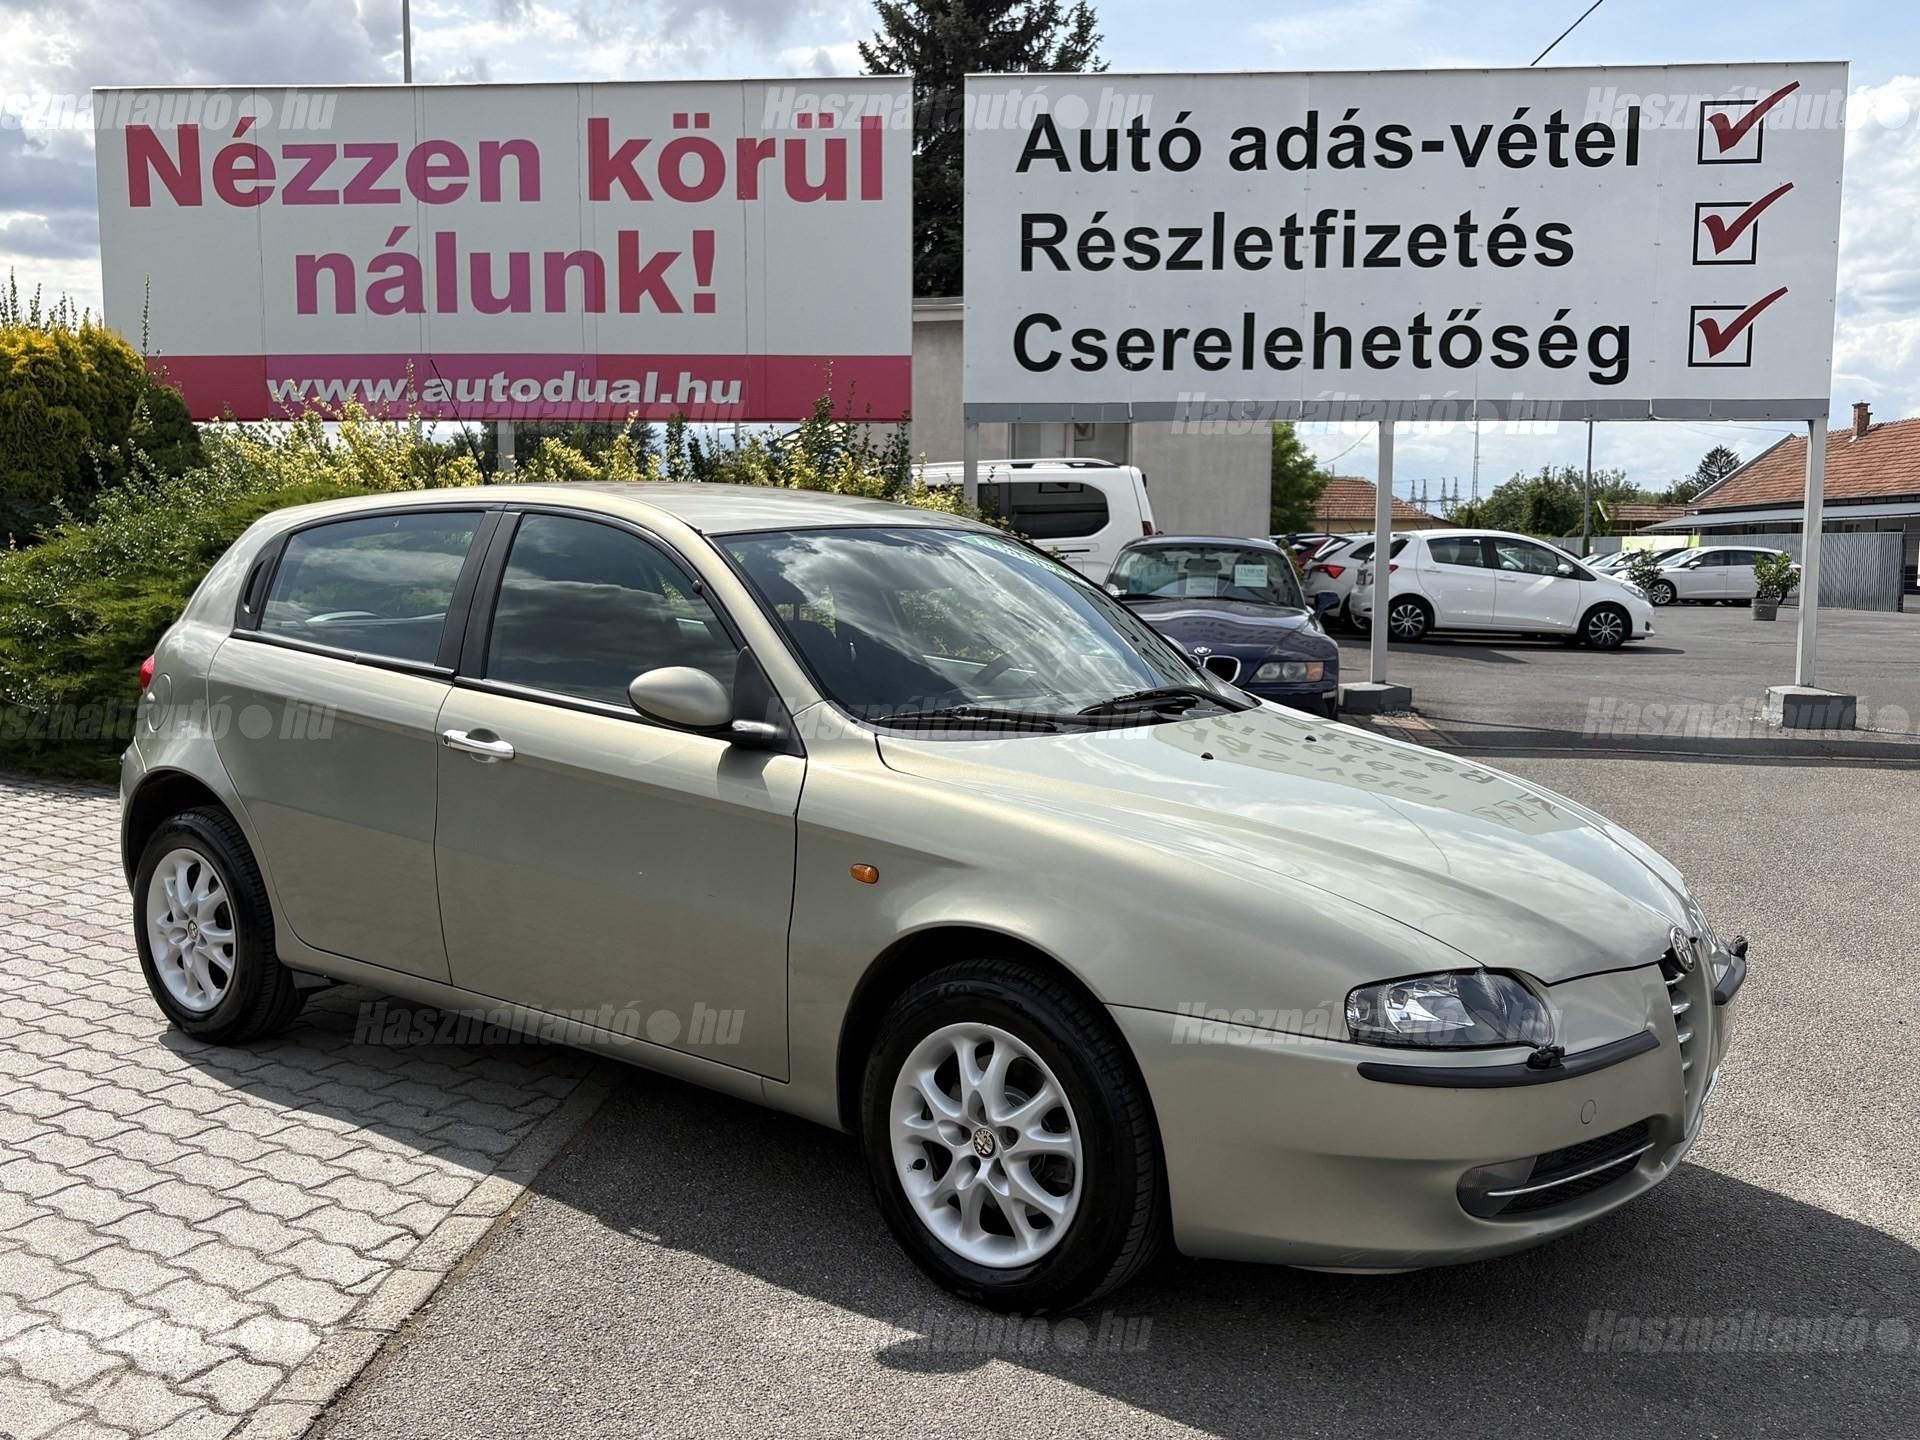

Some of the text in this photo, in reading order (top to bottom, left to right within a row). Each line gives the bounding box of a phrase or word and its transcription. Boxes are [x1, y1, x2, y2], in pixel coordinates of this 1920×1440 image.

[126, 113, 882, 208] Nézzen körül
[1014, 106, 1640, 173] Autó adás-vétel
[296, 225, 715, 315] nálunk!
[1022, 208, 1573, 271] Részletfizetés
[1014, 309, 1629, 385] Cserelehetőség
[267, 370, 742, 405] www.autodual.hu
